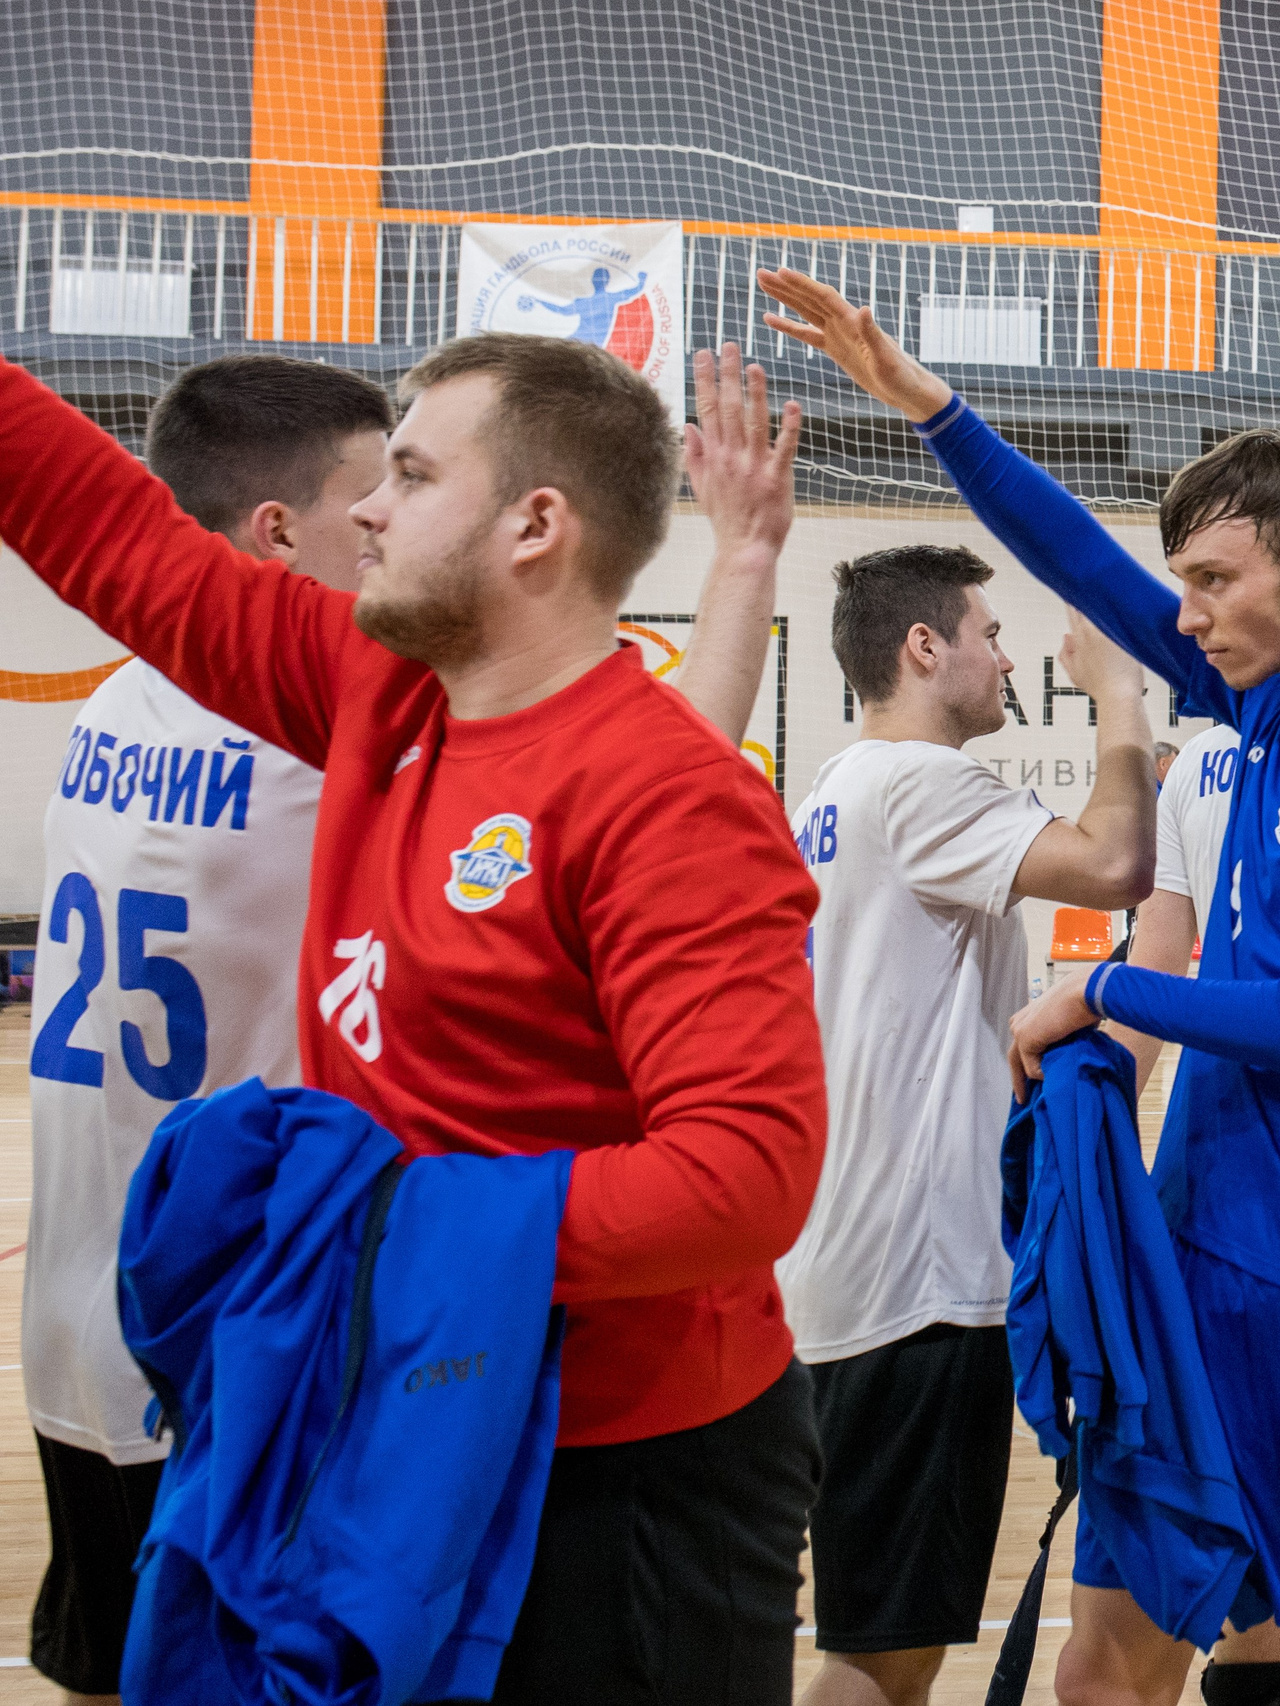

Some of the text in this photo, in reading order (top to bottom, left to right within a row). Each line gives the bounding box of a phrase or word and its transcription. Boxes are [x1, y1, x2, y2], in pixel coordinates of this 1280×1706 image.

[486, 239, 562, 291] ГАНДБОЛА
[567, 238, 631, 264] РОССИИ
[652, 283, 672, 334] RUSSIA
[657, 337, 671, 357] OF
[56, 725, 255, 831] ОБОЧИЙ
[1199, 746, 1240, 798] КО
[30, 871, 208, 1102] 25
[403, 1351, 487, 1393] JAKO
